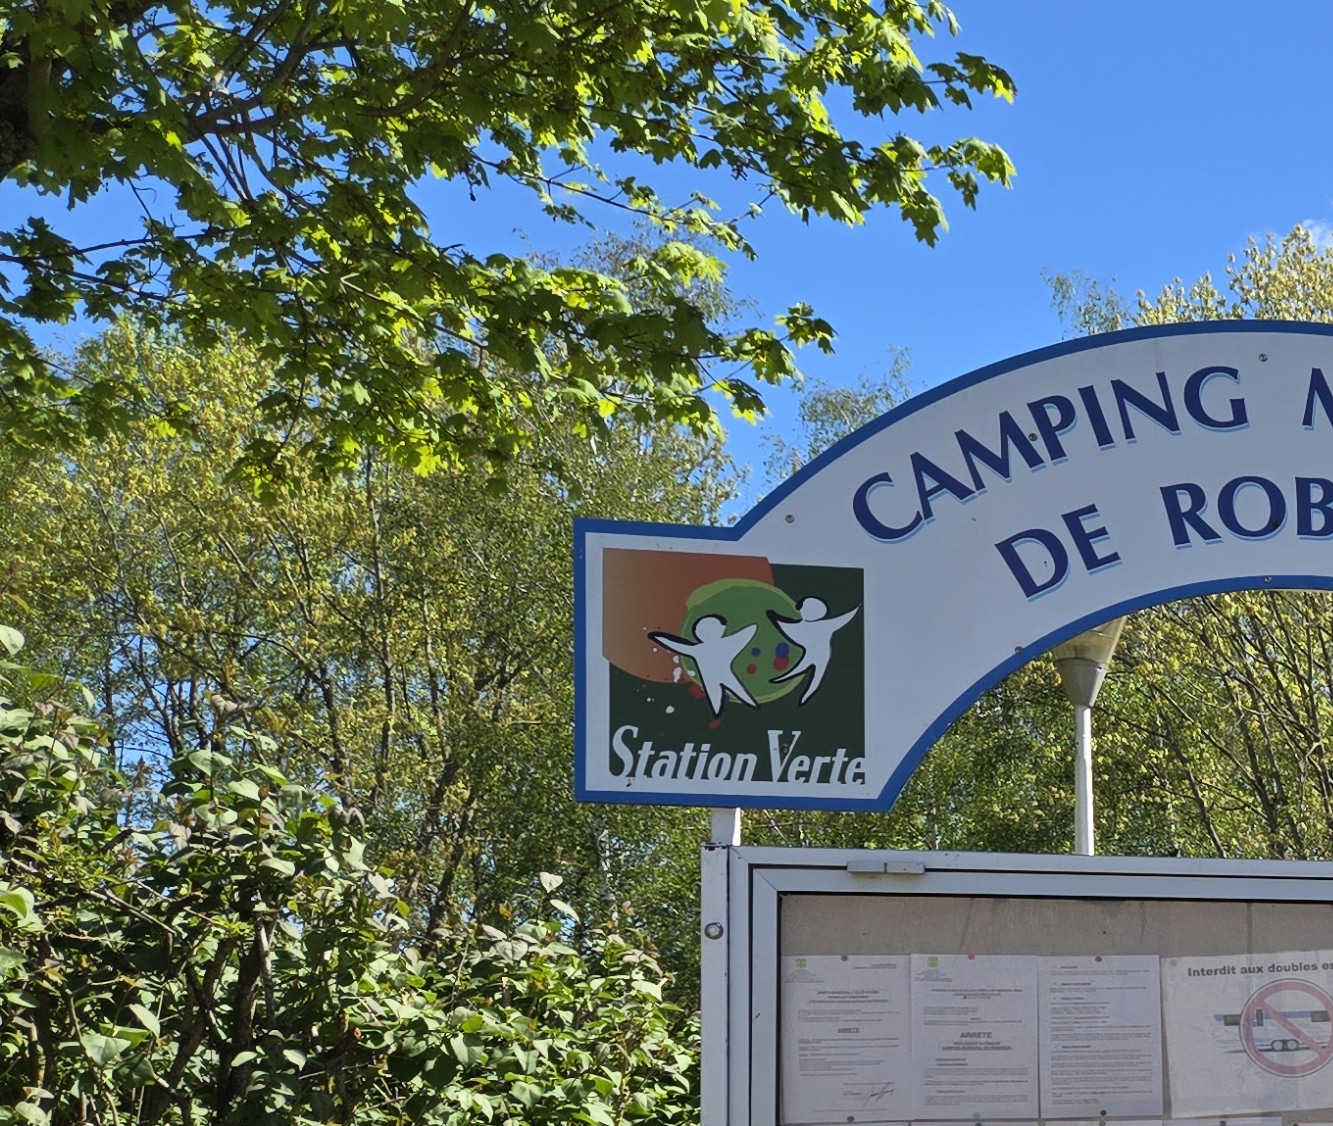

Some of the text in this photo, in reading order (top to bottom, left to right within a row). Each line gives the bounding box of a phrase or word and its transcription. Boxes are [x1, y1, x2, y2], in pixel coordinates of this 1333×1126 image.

[852, 364, 1250, 542] CAMPING
[994, 502, 1122, 600] DE
[612, 724, 866, 786] Station Verte
[1187, 964, 1237, 977] Interdit
[1240, 965, 1264, 975] aux
[1267, 961, 1318, 973] doubles
